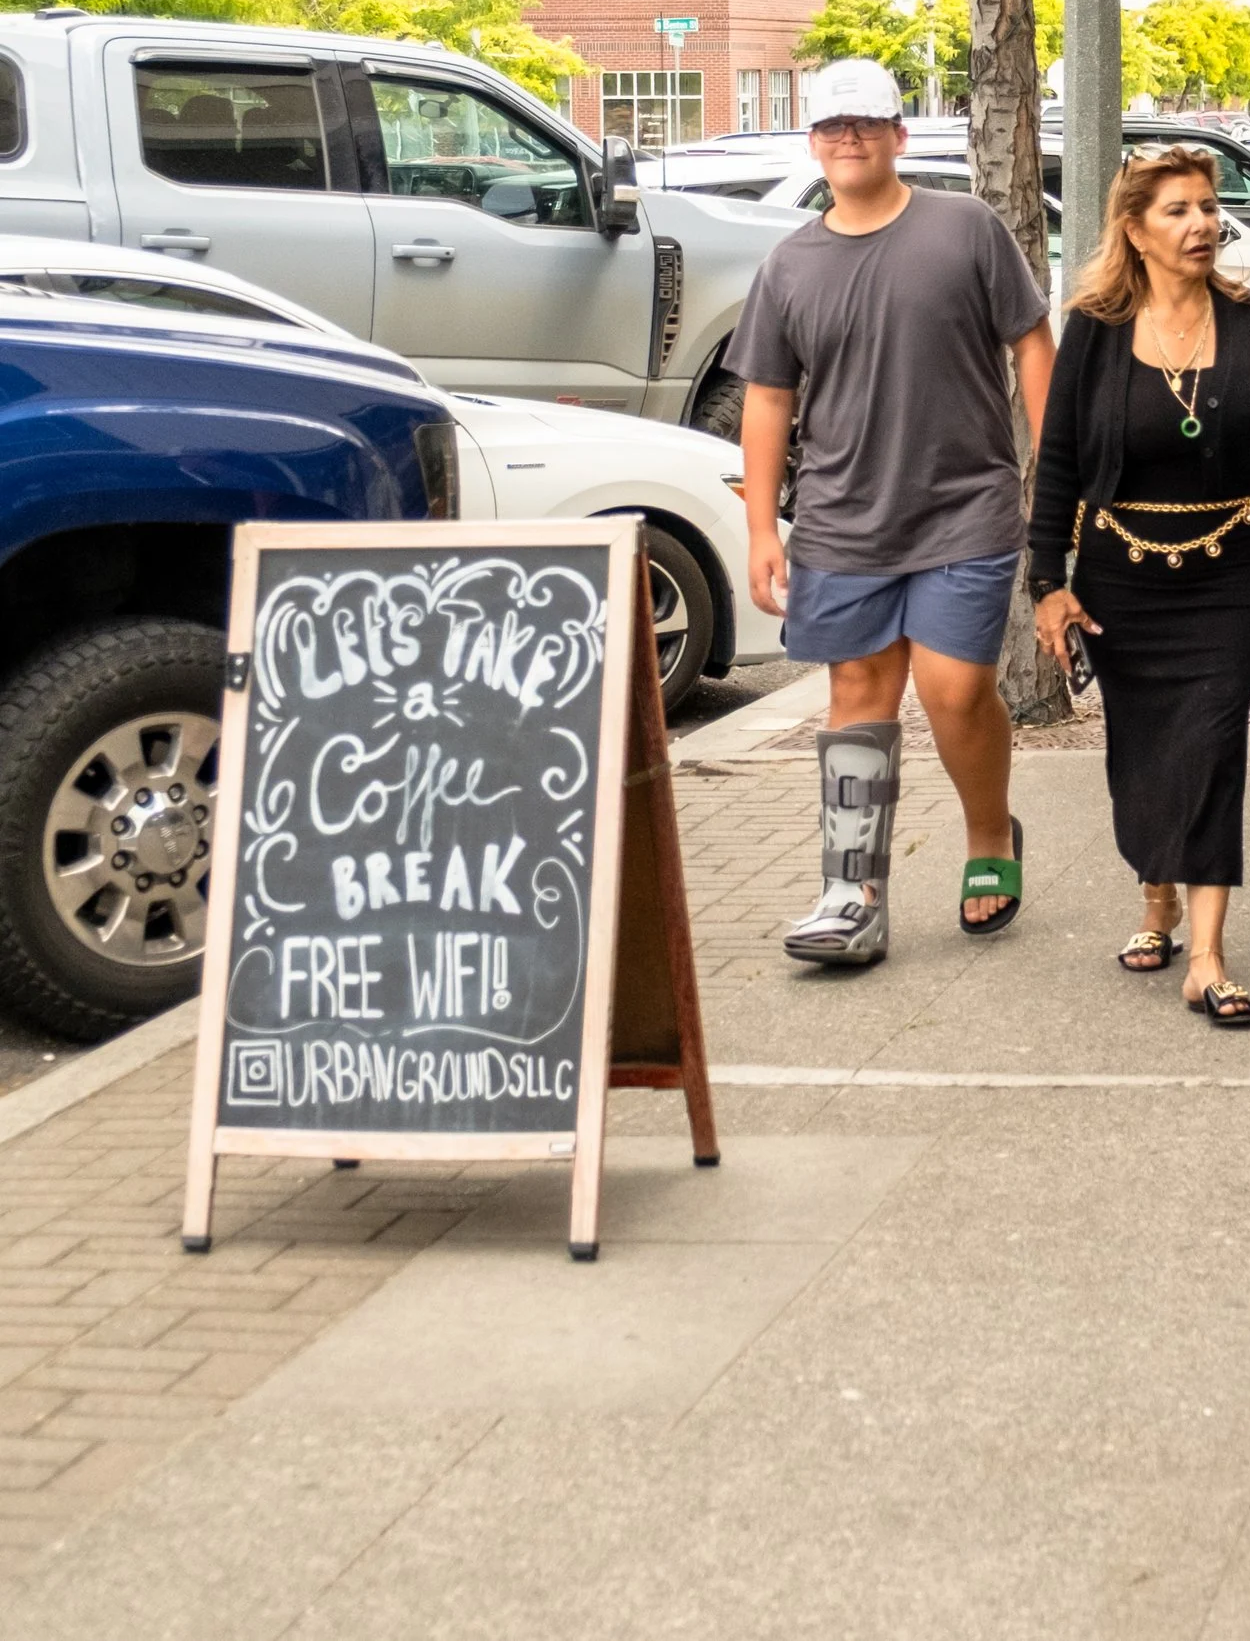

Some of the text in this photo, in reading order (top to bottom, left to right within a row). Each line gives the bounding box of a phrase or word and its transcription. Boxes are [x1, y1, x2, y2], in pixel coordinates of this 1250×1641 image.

[436, 598, 565, 707] TAKE
[402, 680, 440, 720] a
[310, 730, 523, 852] Coffee
[331, 834, 527, 920] BREAK
[968, 874, 999, 888] PUMA
[280, 934, 385, 1019] FREE
